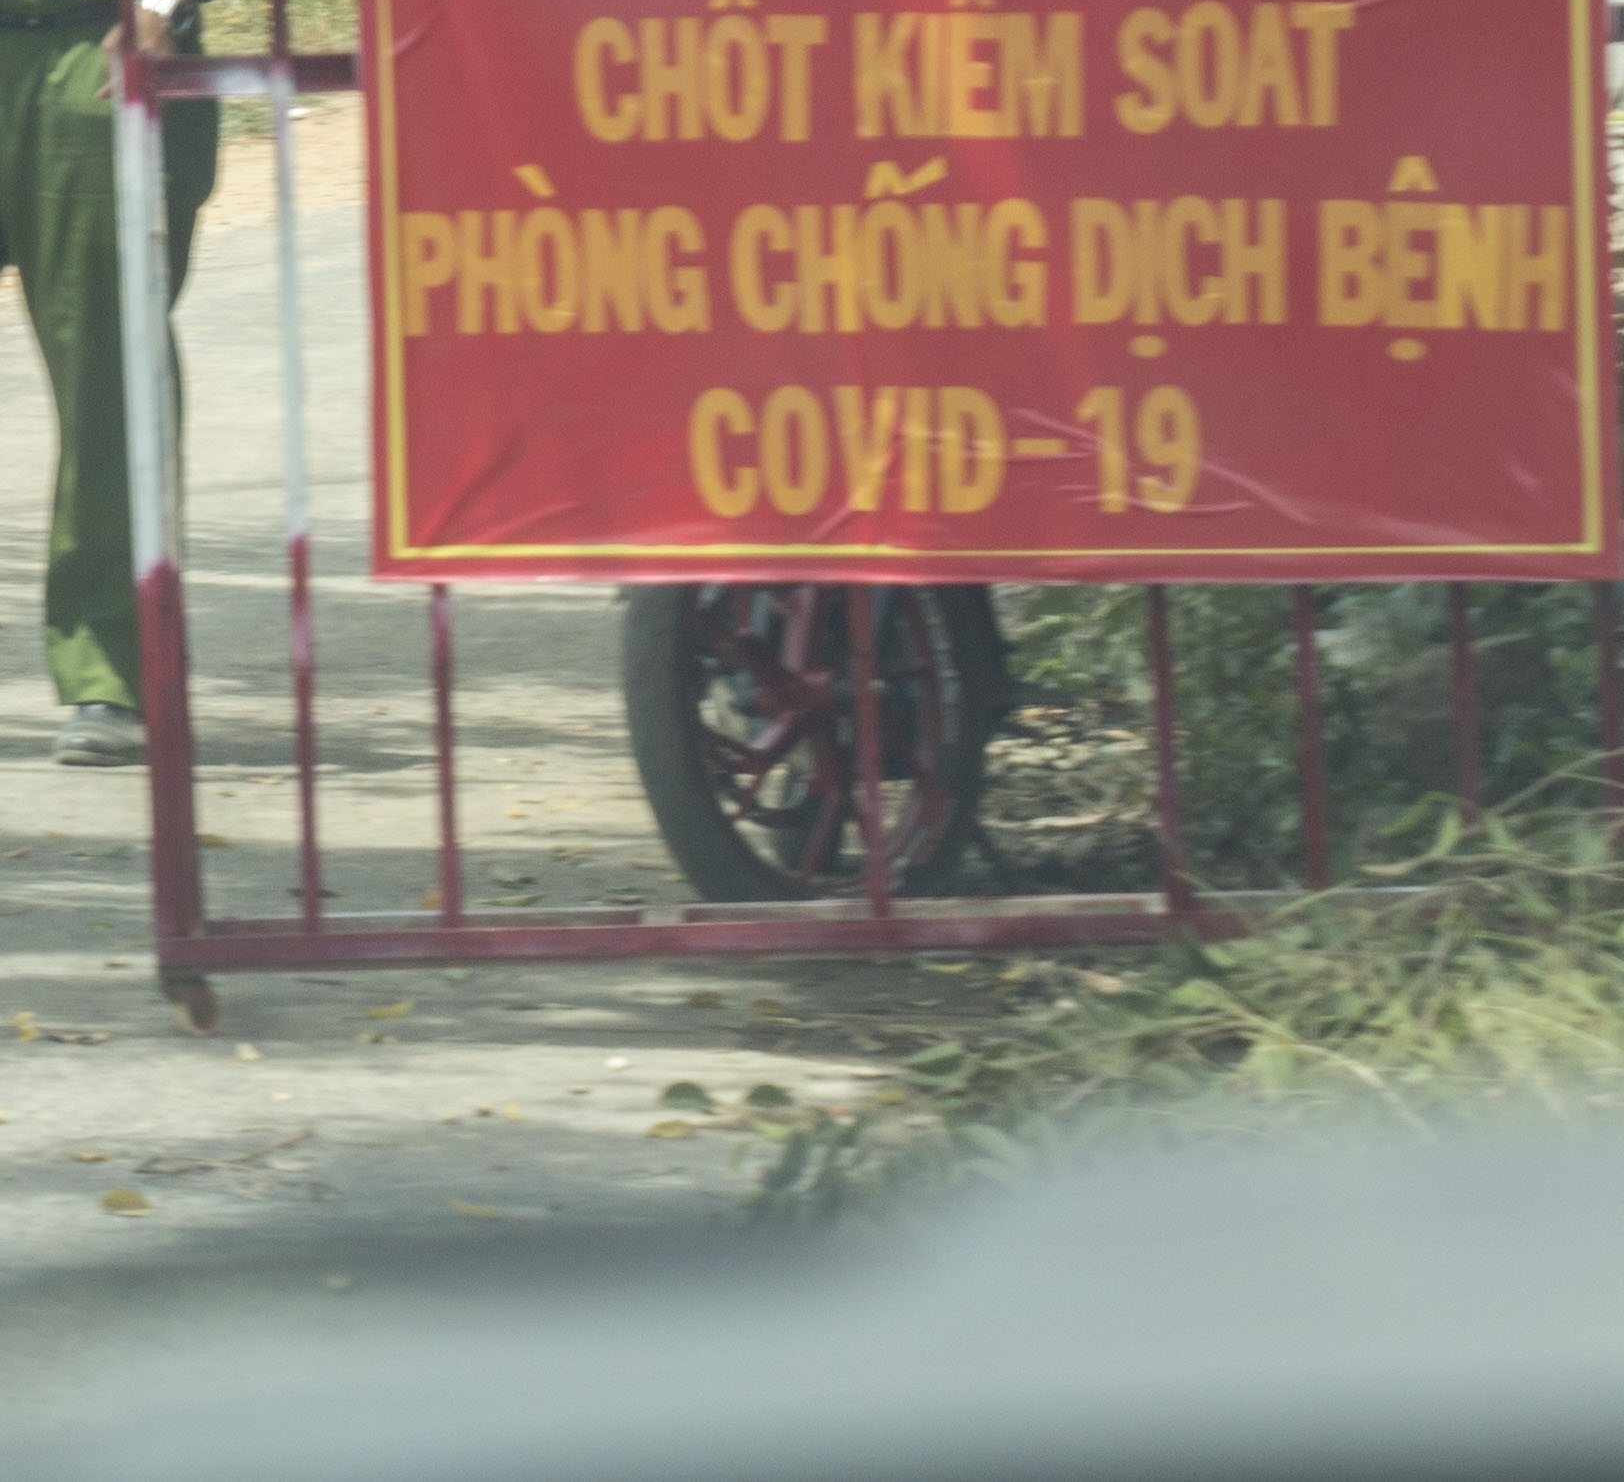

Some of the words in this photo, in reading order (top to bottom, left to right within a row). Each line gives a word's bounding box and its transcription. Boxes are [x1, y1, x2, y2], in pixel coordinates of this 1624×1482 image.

[403, 164, 711, 337] PHÒNG
[1074, 195, 1287, 358] DỊCH
[1319, 155, 1569, 361] BỆNH
[688, 385, 1202, 517] COVID-19
